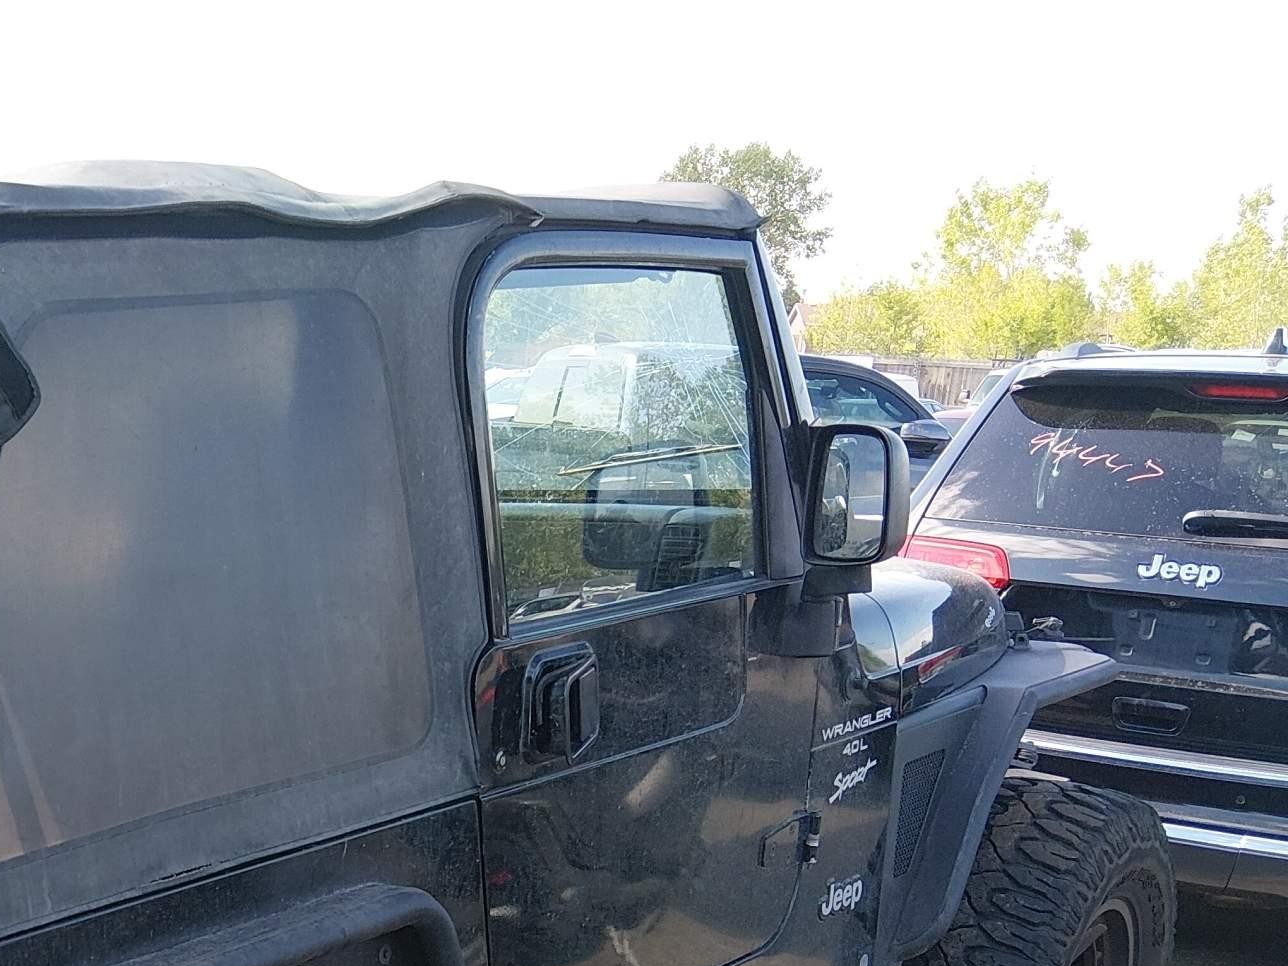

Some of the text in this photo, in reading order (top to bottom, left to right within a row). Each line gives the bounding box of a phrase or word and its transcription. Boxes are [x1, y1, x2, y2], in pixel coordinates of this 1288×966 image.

[1137, 552, 1222, 590] Jeep
[822, 707, 892, 741] WRANGLER
[829, 757, 877, 804] Sport
[821, 879, 863, 916] Jeep
